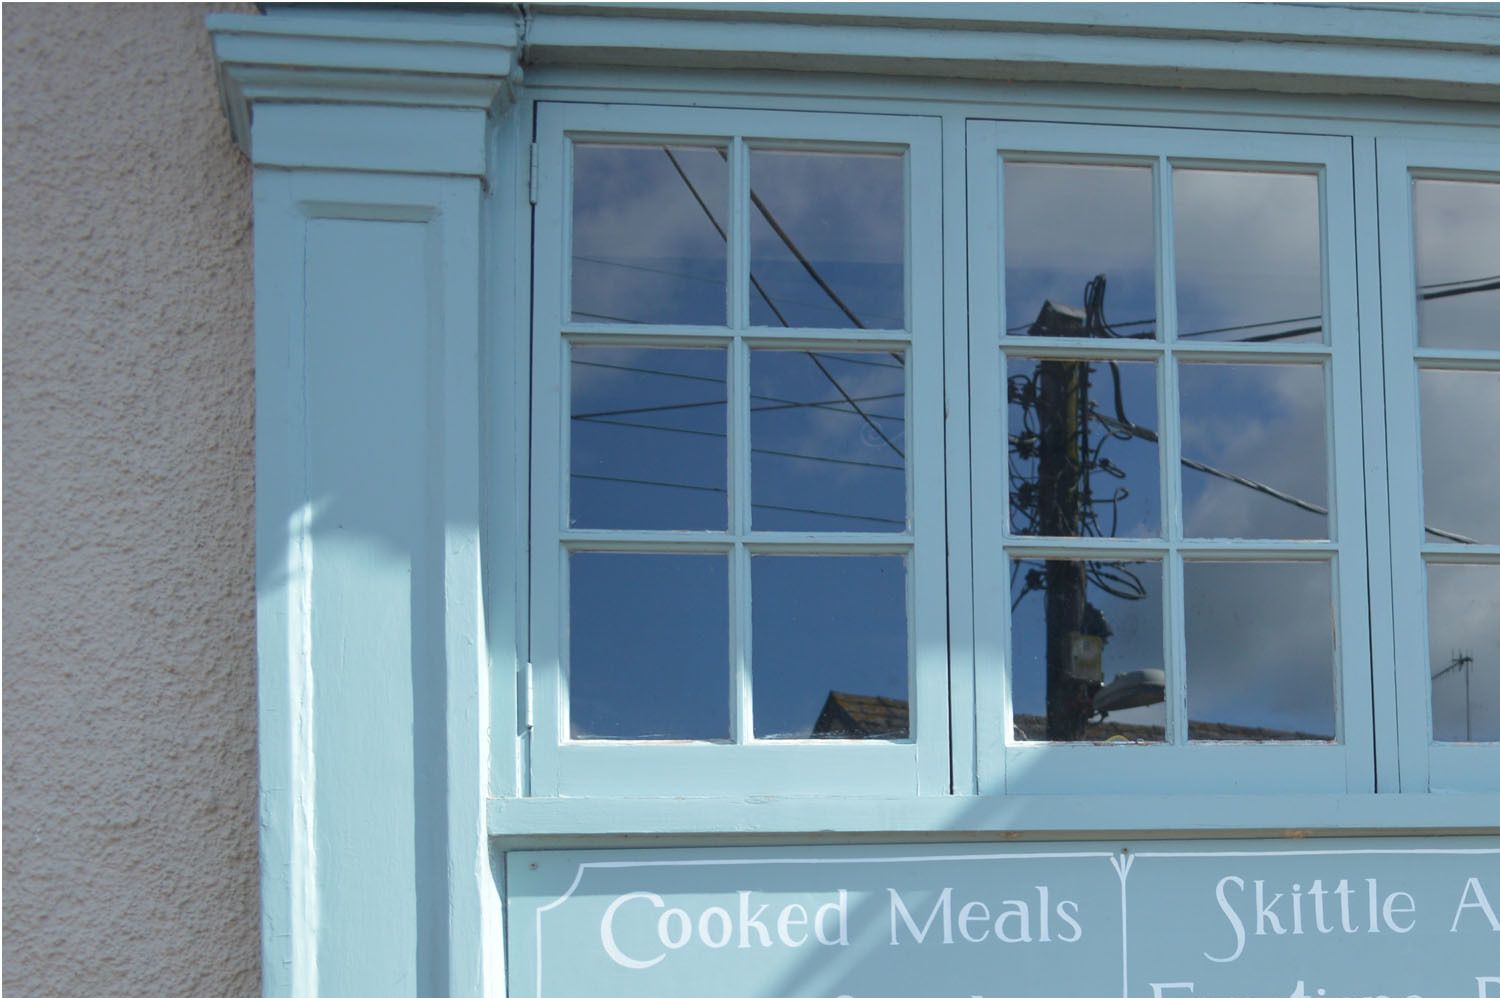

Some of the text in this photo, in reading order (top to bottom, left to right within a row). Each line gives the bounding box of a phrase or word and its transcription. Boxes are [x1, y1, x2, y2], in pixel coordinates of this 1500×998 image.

[600, 885, 1083, 969] Cooked Meals
[1203, 875, 1416, 963] Skittle
